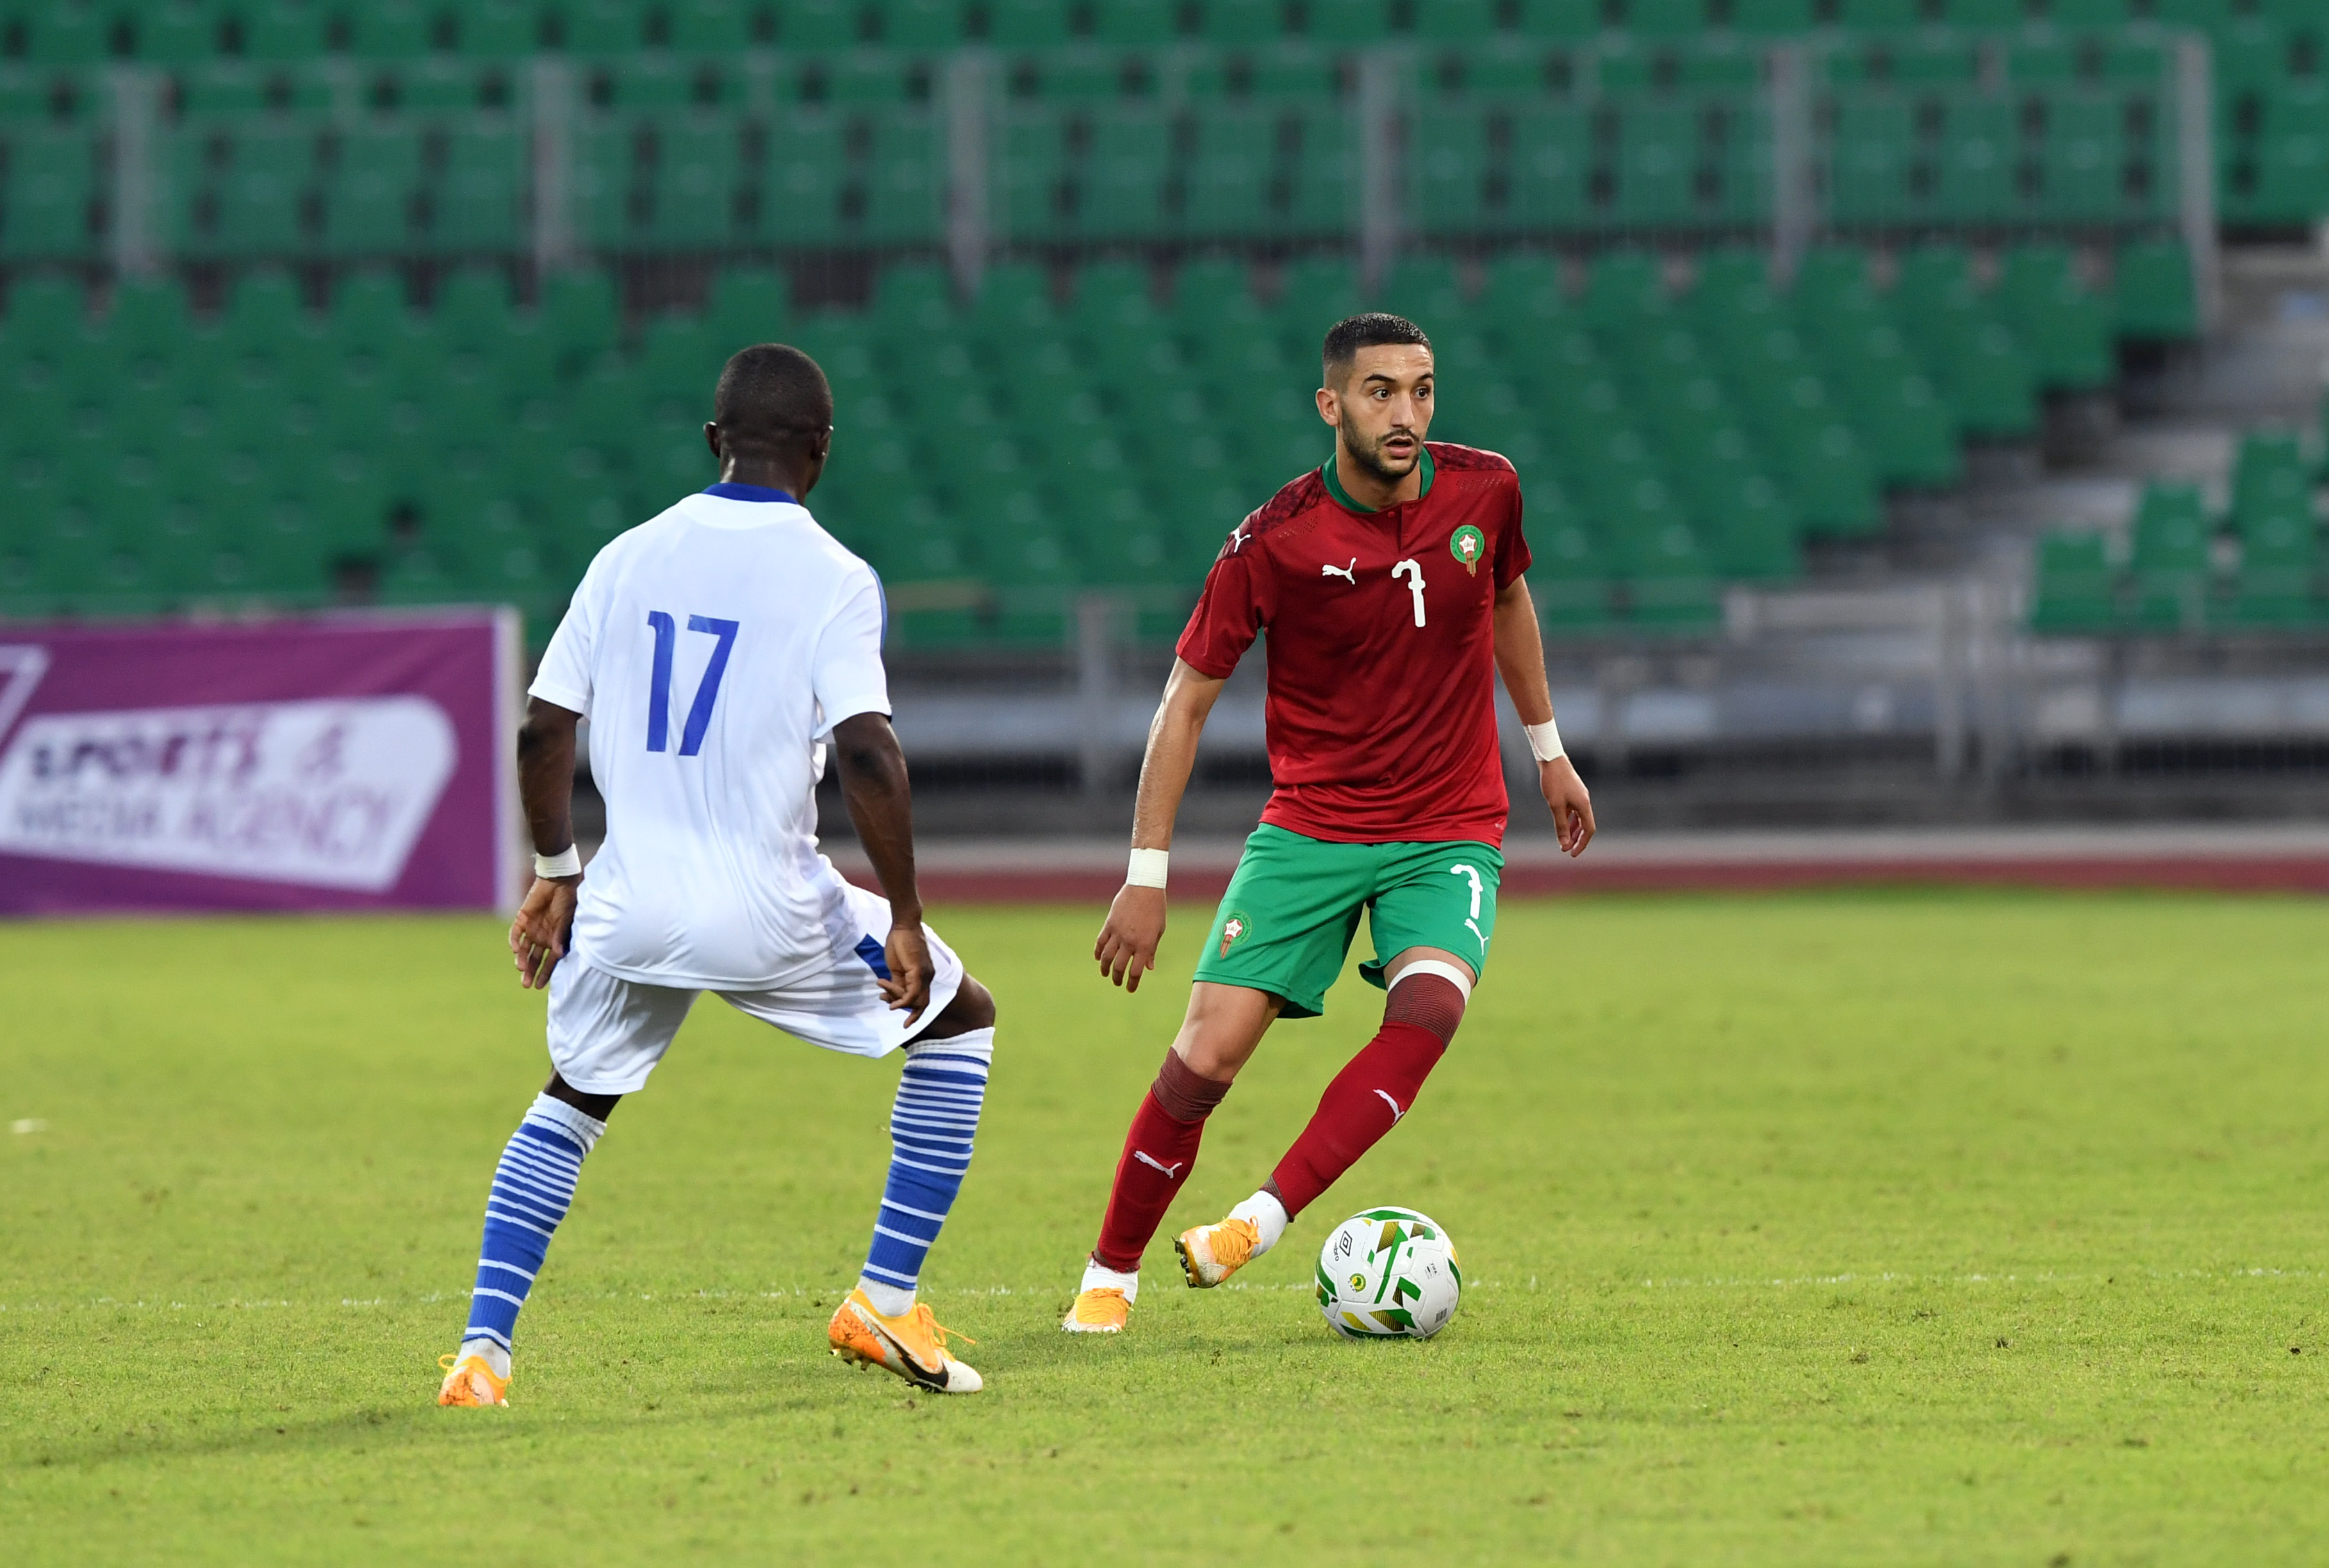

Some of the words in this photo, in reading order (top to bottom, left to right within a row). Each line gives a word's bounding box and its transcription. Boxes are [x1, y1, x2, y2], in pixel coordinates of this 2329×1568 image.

[1391, 558, 1426, 627] 7
[646, 610, 740, 757] 17
[1450, 864, 1484, 920] 7
